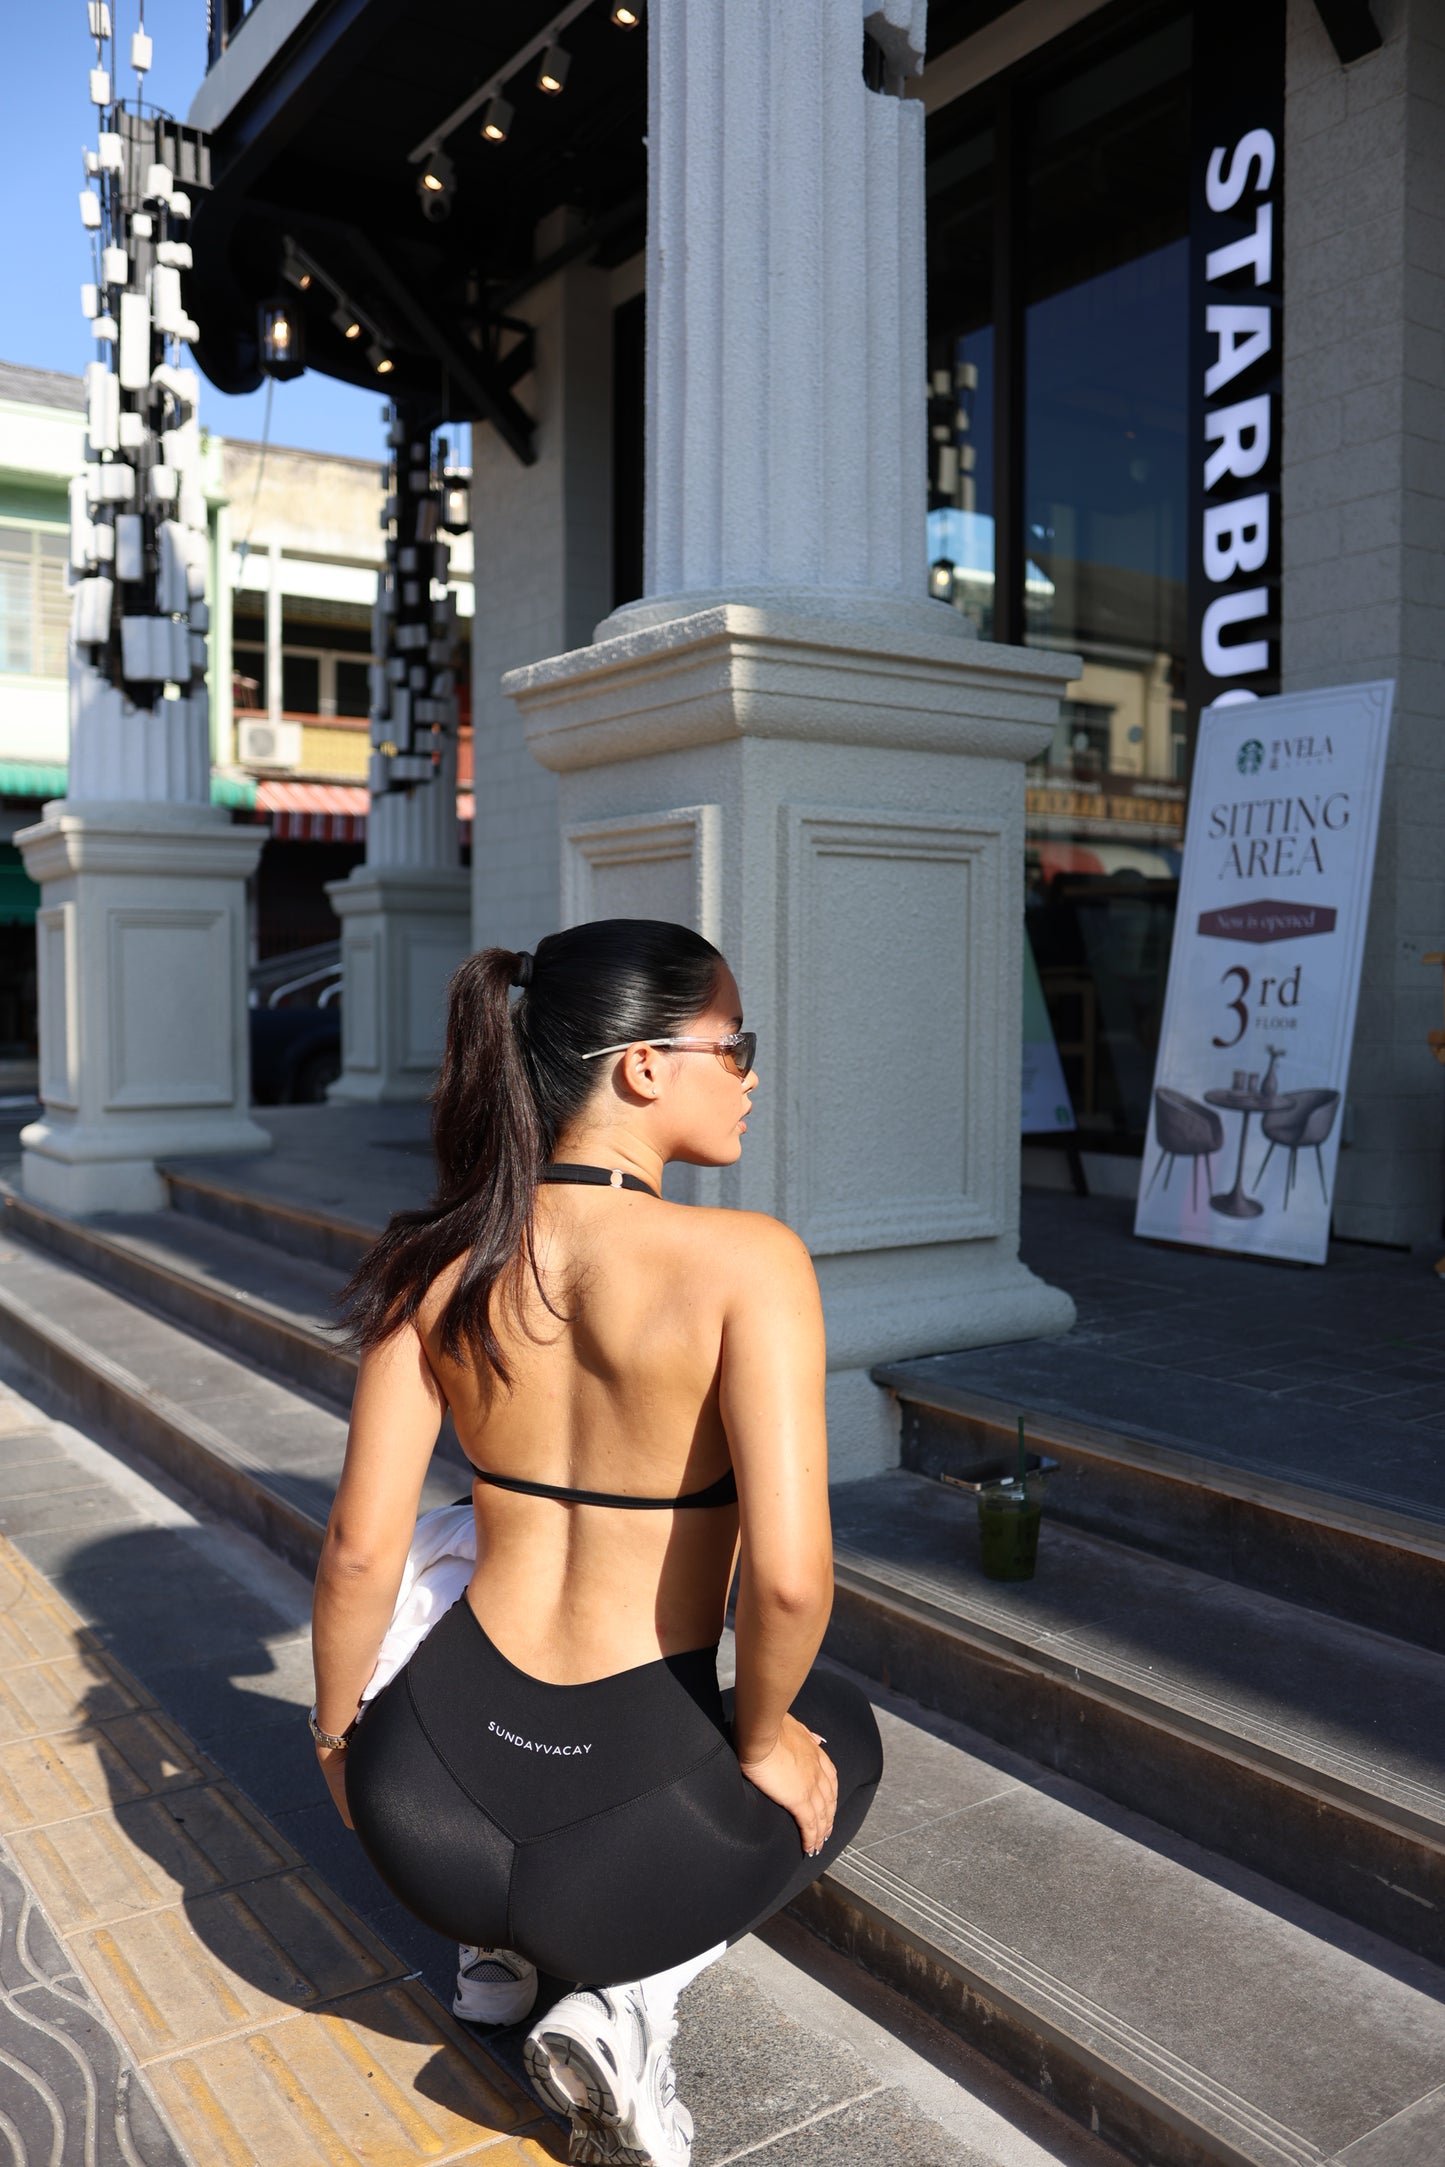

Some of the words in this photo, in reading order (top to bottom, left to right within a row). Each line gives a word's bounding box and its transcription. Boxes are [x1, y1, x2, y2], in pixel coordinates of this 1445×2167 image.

[1200, 127, 1275, 708] STARBU
[1208, 792, 1349, 840] SITTING
[1218, 836, 1324, 880] AREA
[1255, 1016, 1298, 1030] FLOOR
[487, 1721, 592, 1756] SUNDAYVACAY
